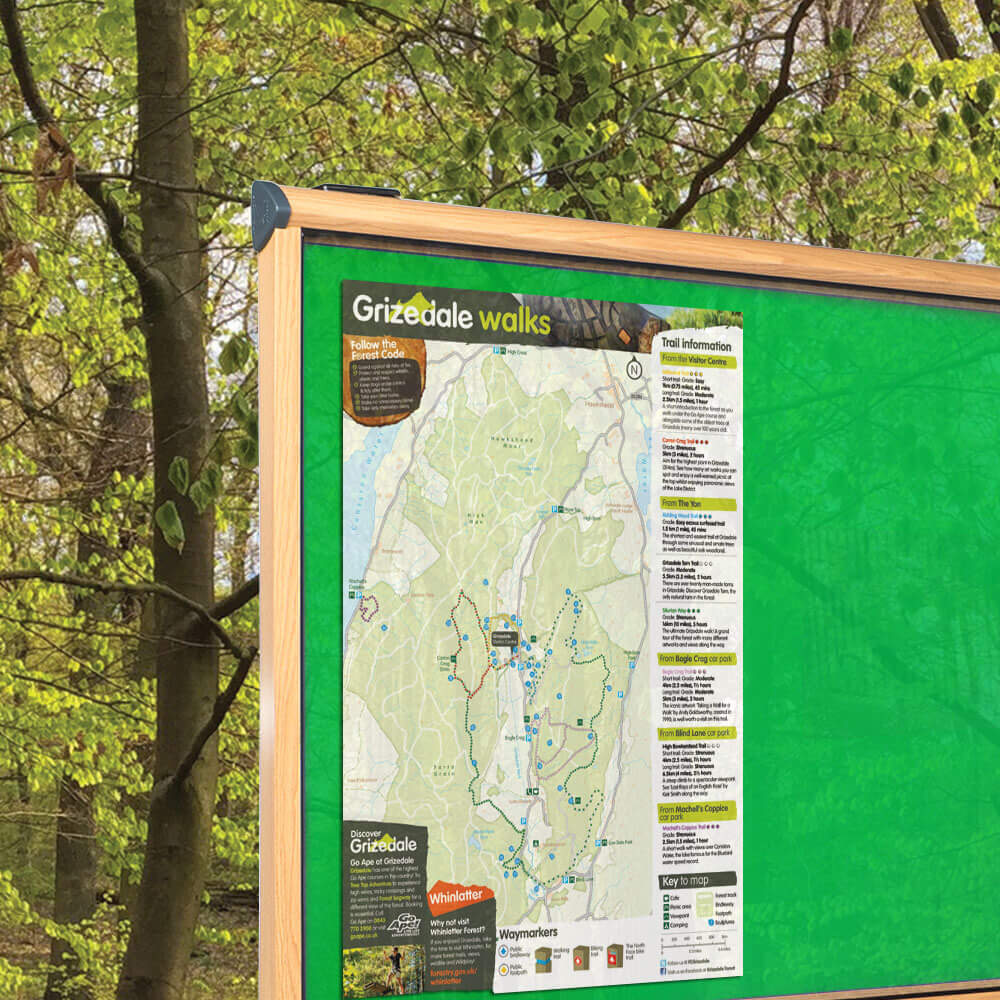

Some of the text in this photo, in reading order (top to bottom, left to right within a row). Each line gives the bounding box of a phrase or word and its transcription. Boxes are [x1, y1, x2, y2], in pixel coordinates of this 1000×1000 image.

[352, 294, 551, 334] Grizedale walks
[351, 339, 396, 350] Follow the
[662, 337, 680, 348] Trail
[352, 349, 404, 360] Forest Code
[630, 365, 638, 375] N
[675, 655, 692, 664] Bogle
[676, 805, 703, 814] Machell's
[704, 805, 728, 813] Coppice
[350, 829, 381, 838] Discover
[350, 836, 417, 853] Grizedale
[384, 856, 414, 864] Grizedale
[662, 876, 709, 887] Key to map
[429, 889, 482, 904] Whinlatter
[398, 913, 416, 923] Go
[387, 919, 421, 933] Ape!
[464, 926, 486, 934] Forest?
[499, 926, 558, 941] Waymarkers
